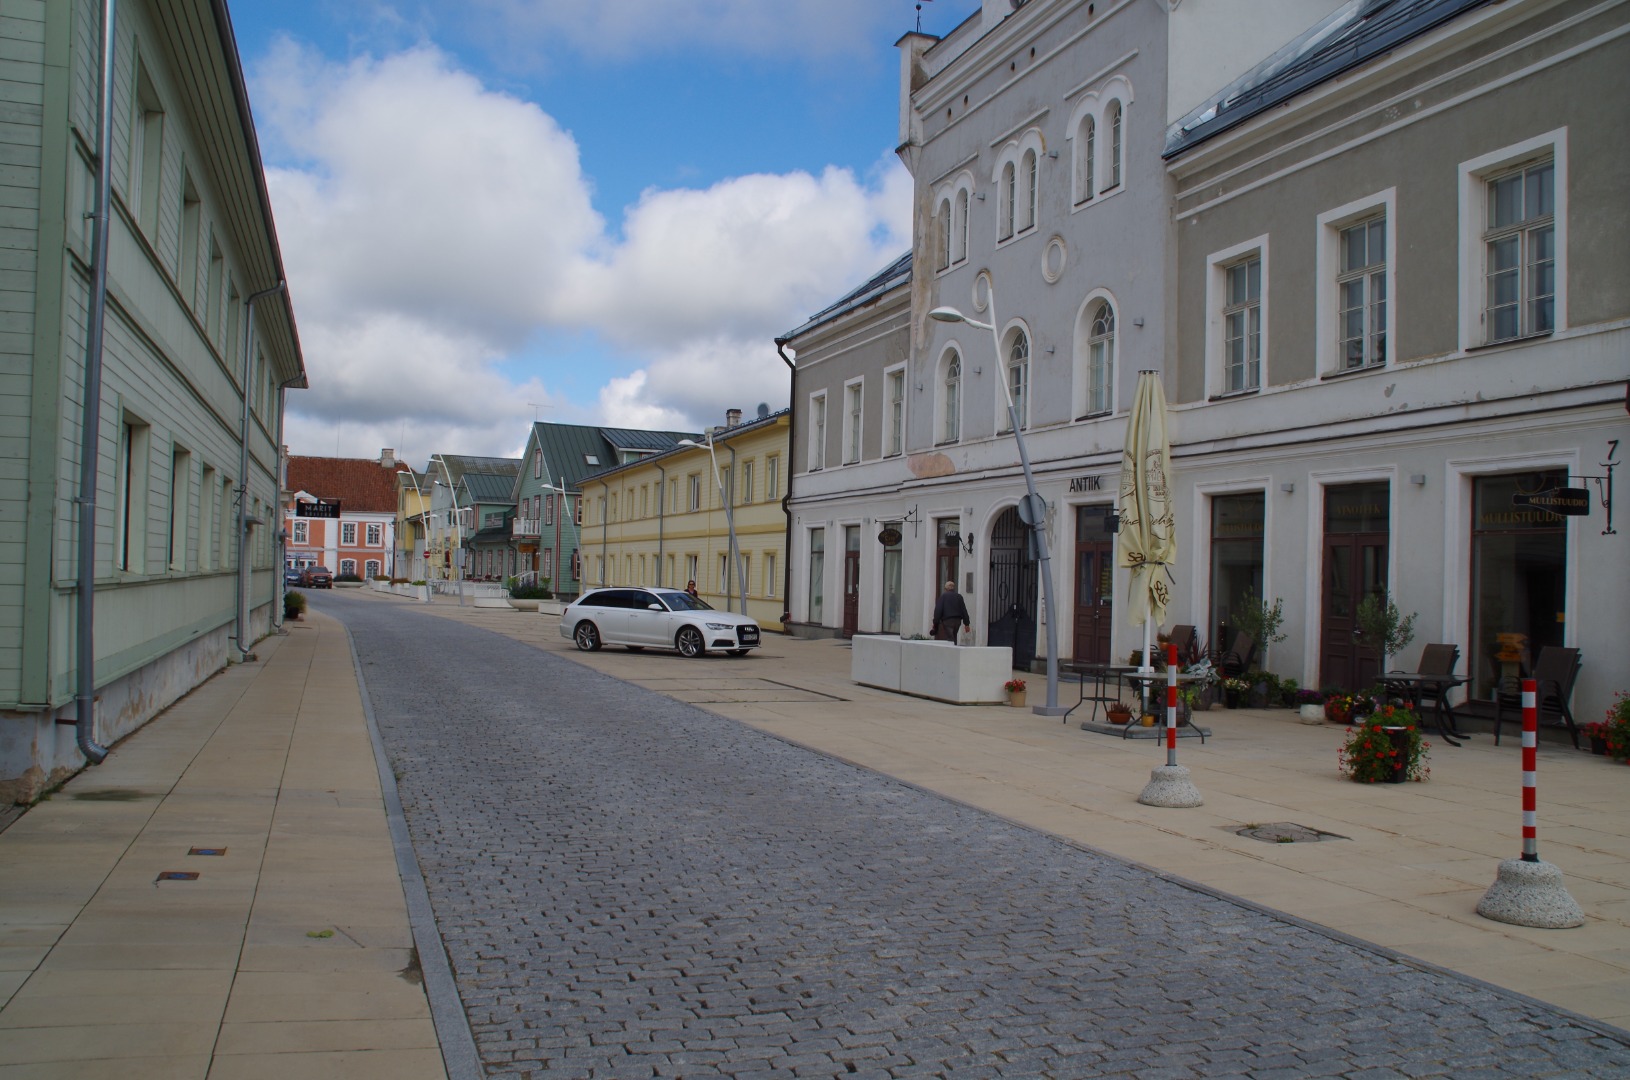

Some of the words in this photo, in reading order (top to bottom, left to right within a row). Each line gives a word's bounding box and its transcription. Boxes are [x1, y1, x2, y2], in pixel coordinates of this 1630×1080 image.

[1608, 439, 1619, 461] 7
[1069, 476, 1101, 493] ANTIIK
[1529, 497, 1588, 507] MULLISTUUDIO
